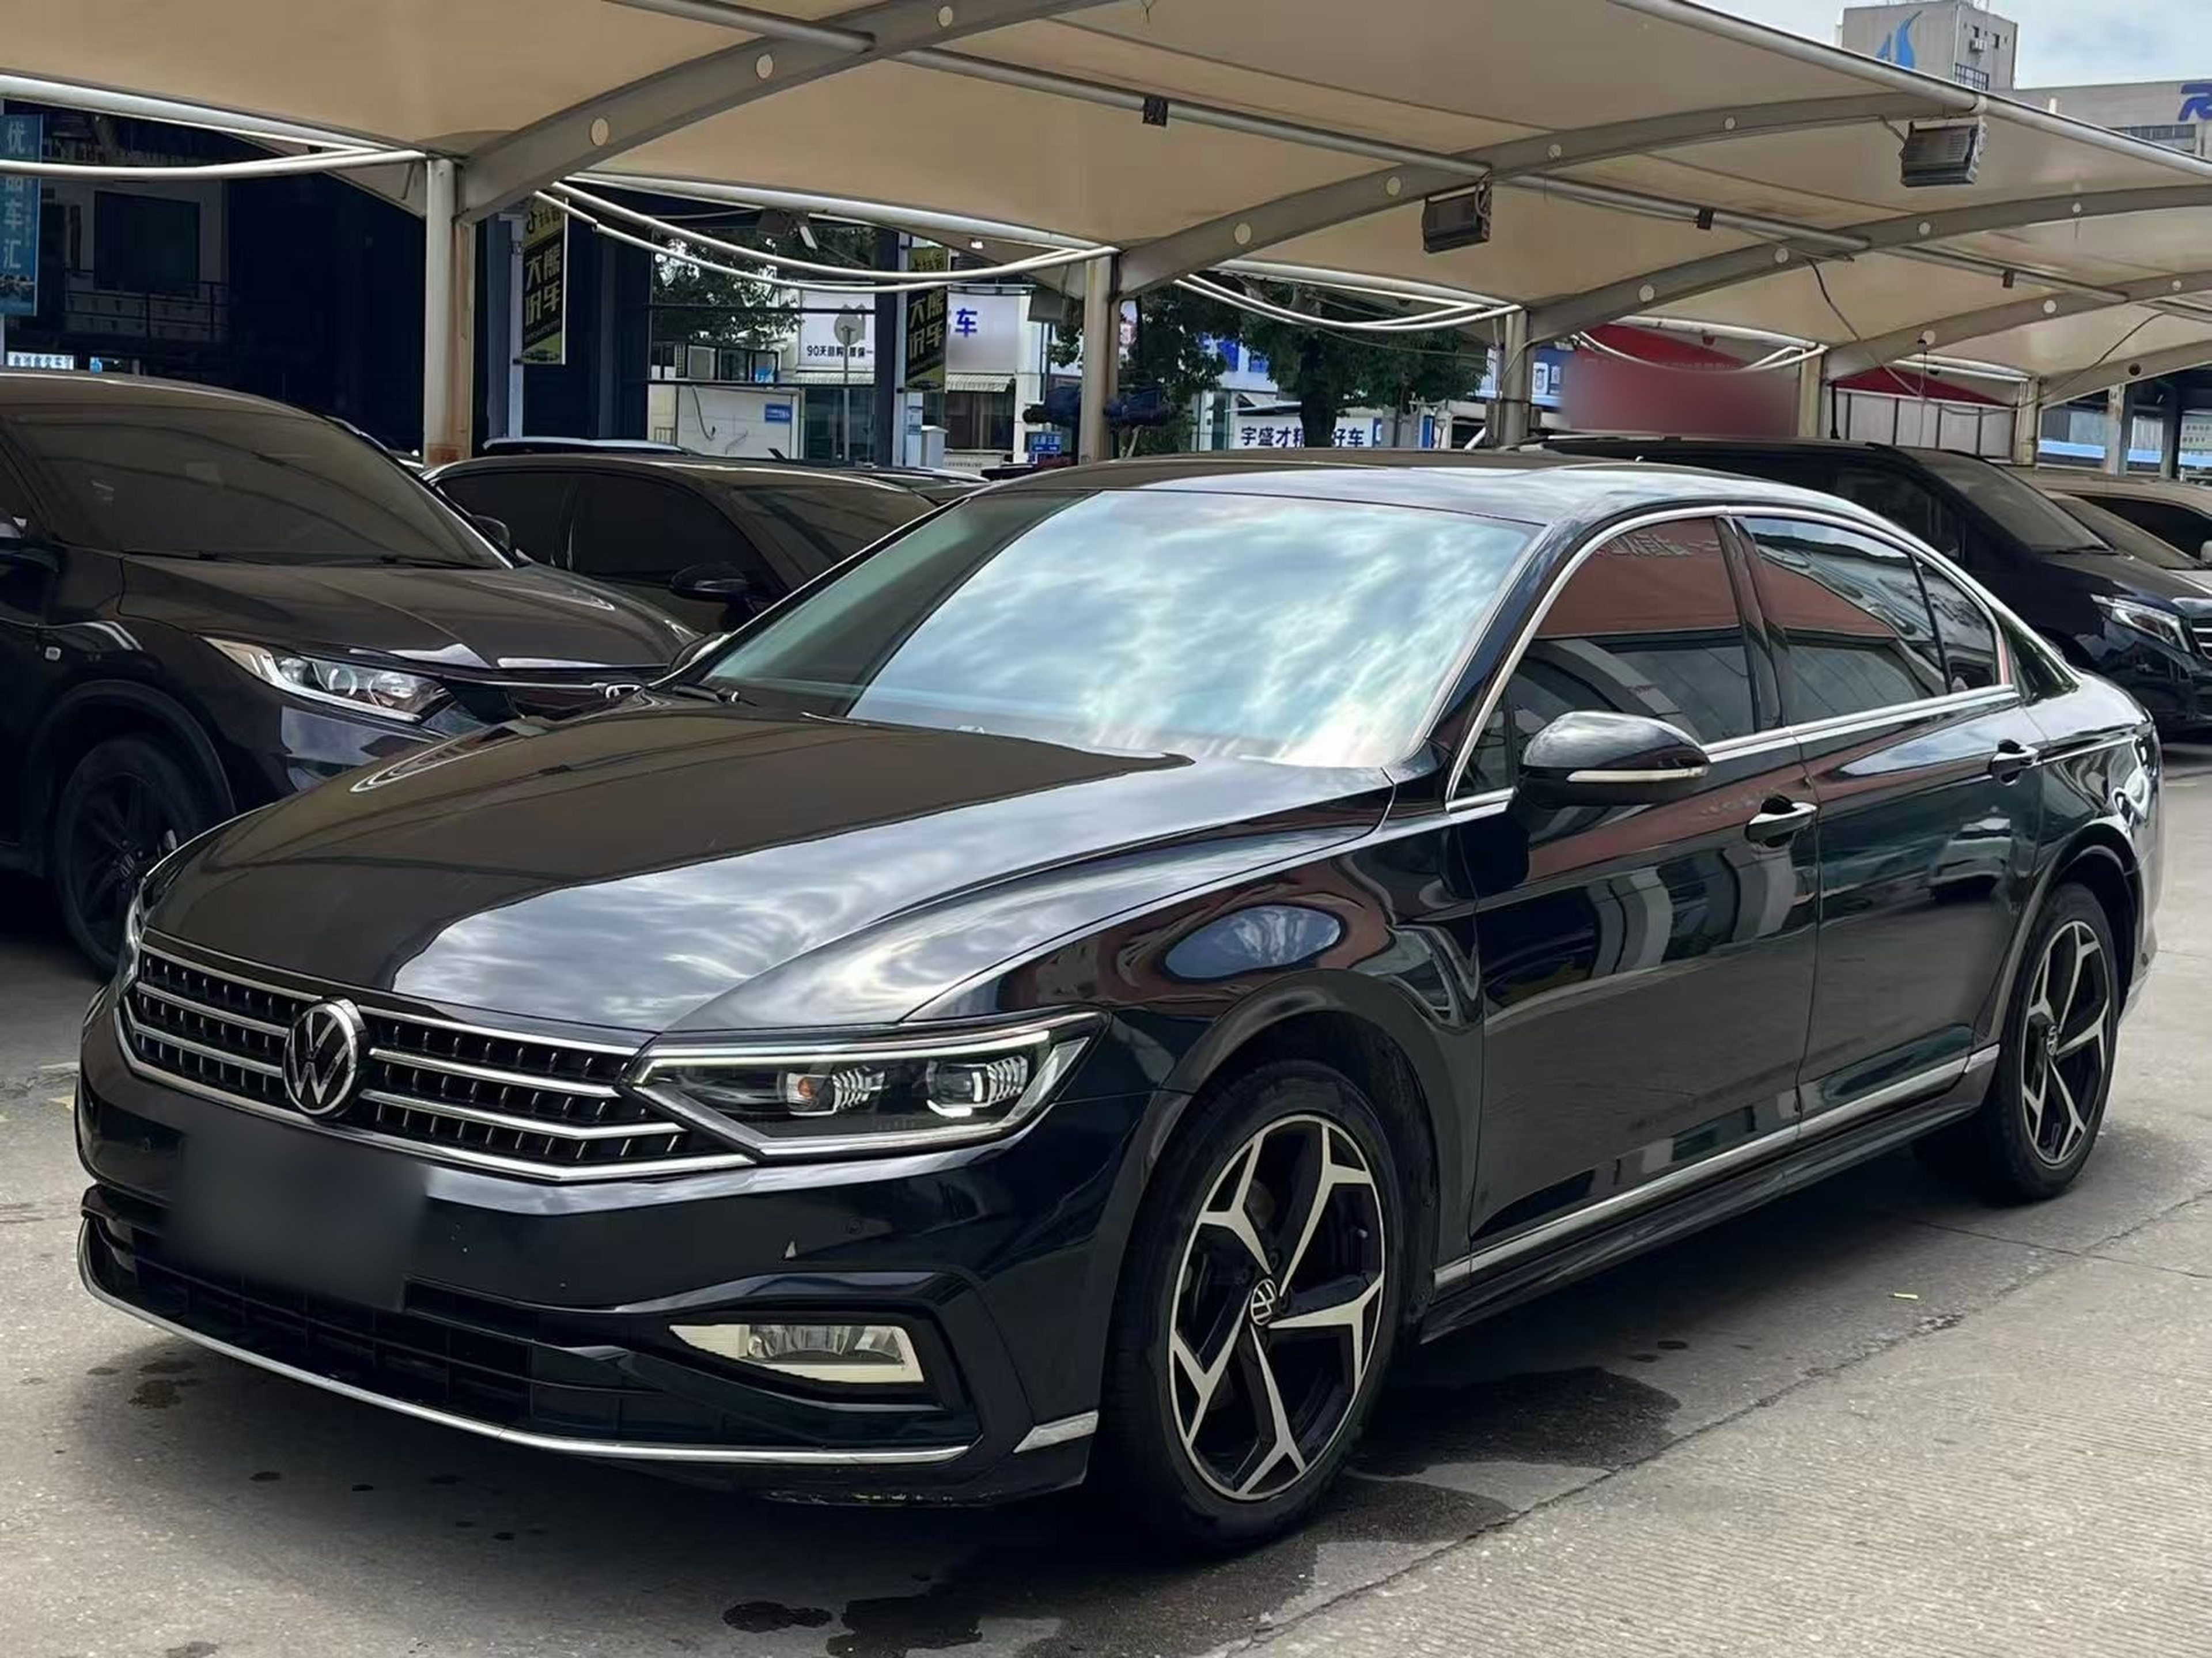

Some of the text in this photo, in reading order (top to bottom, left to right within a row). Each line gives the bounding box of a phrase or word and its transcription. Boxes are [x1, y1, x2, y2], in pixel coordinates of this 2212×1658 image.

[948, 307, 978, 338] 车
[1241, 426, 1364, 448] 宇盛才精好车
